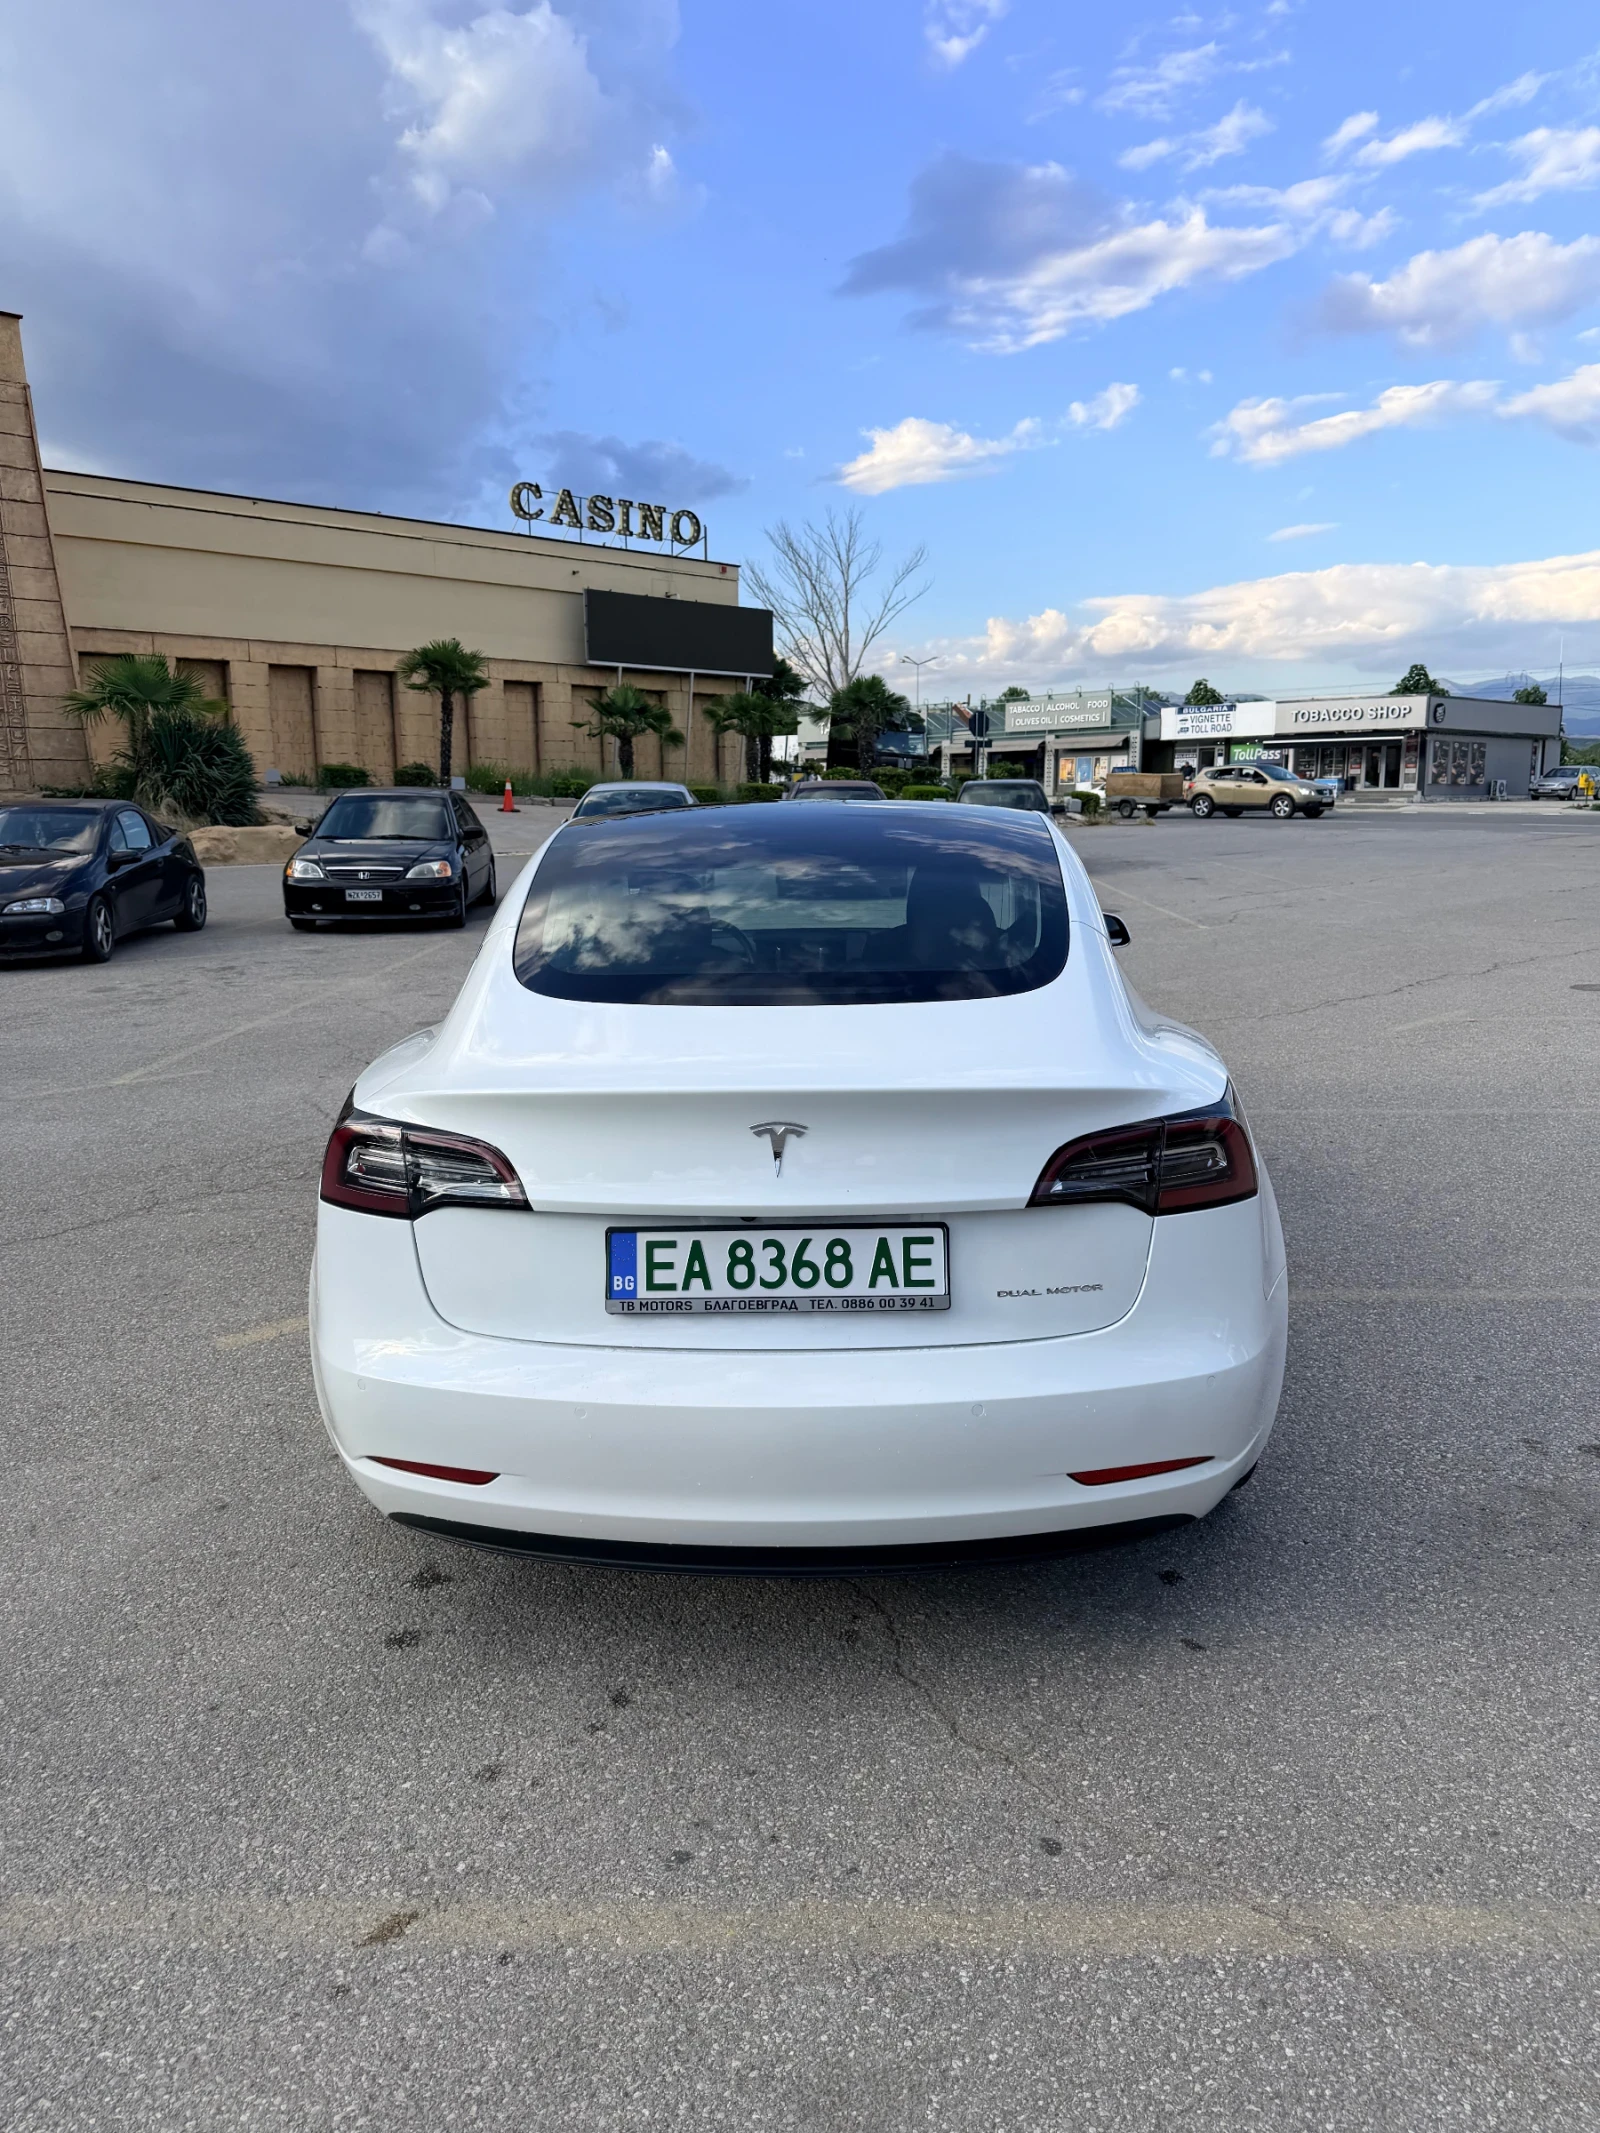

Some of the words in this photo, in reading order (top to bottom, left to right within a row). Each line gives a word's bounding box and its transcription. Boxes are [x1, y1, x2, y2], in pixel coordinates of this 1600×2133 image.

[510, 482, 701, 545] CASINO
[1009, 704, 1040, 714] TABACCO
[1046, 702, 1080, 711] ALCOHOL
[1087, 700, 1108, 709] FOOD
[1183, 705, 1229, 714] BULGARIA
[1015, 717, 1040, 726] OLIVES
[1041, 716, 1053, 724] OIL
[1060, 713, 1100, 723] COSMETICS
[1190, 714, 1231, 724] VIGNETTE
[1291, 707, 1363, 723] TOBACCO
[1367, 705, 1412, 720] SHOP
[1191, 724, 1209, 733] TOLL
[1211, 723, 1233, 733] ROAD
[1234, 748, 1281, 761] TollPass
[613, 1275, 635, 1291] BG
[645, 1239, 713, 1291] EA
[726, 1237, 854, 1290] 8368
[868, 1236, 935, 1288] AE
[997, 1289, 1042, 1298] DUAL
[1046, 1283, 1104, 1295] MOTOR
[639, 1300, 693, 1312] MOTORS
[704, 1299, 799, 1311] БЛАГОЕВГРАД
[841, 1298, 875, 1309] 0886
[879, 1298, 896, 1309] 00
[899, 1297, 916, 1308] 39
[919, 1297, 935, 1308] 41
